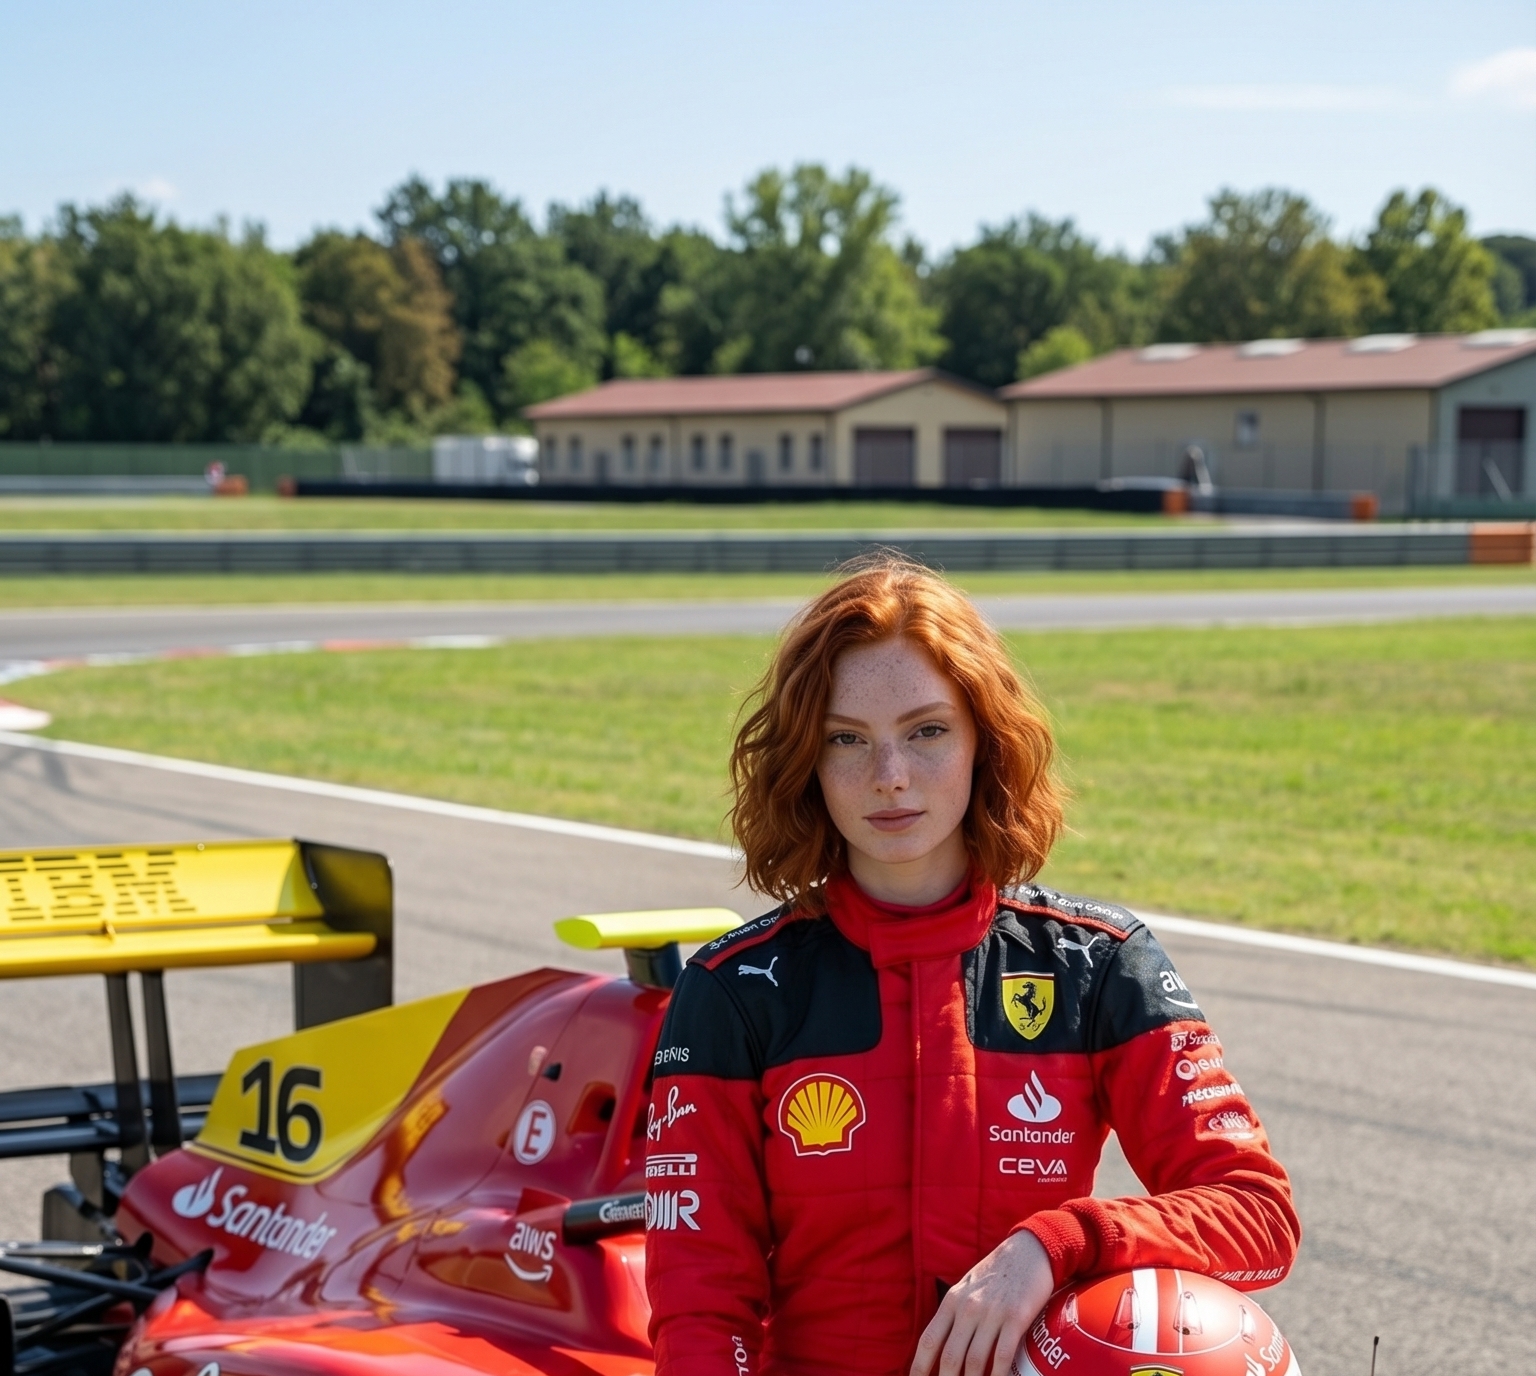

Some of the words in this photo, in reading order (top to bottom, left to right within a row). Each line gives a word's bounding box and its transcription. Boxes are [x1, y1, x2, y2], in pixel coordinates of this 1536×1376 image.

[0, 851, 196, 921] IBM
[1159, 969, 1189, 993] aw
[239, 1058, 322, 1164] 16
[522, 1110, 547, 1156] E
[989, 1124, 1075, 1144] Santander
[206, 1184, 337, 1259] Santander
